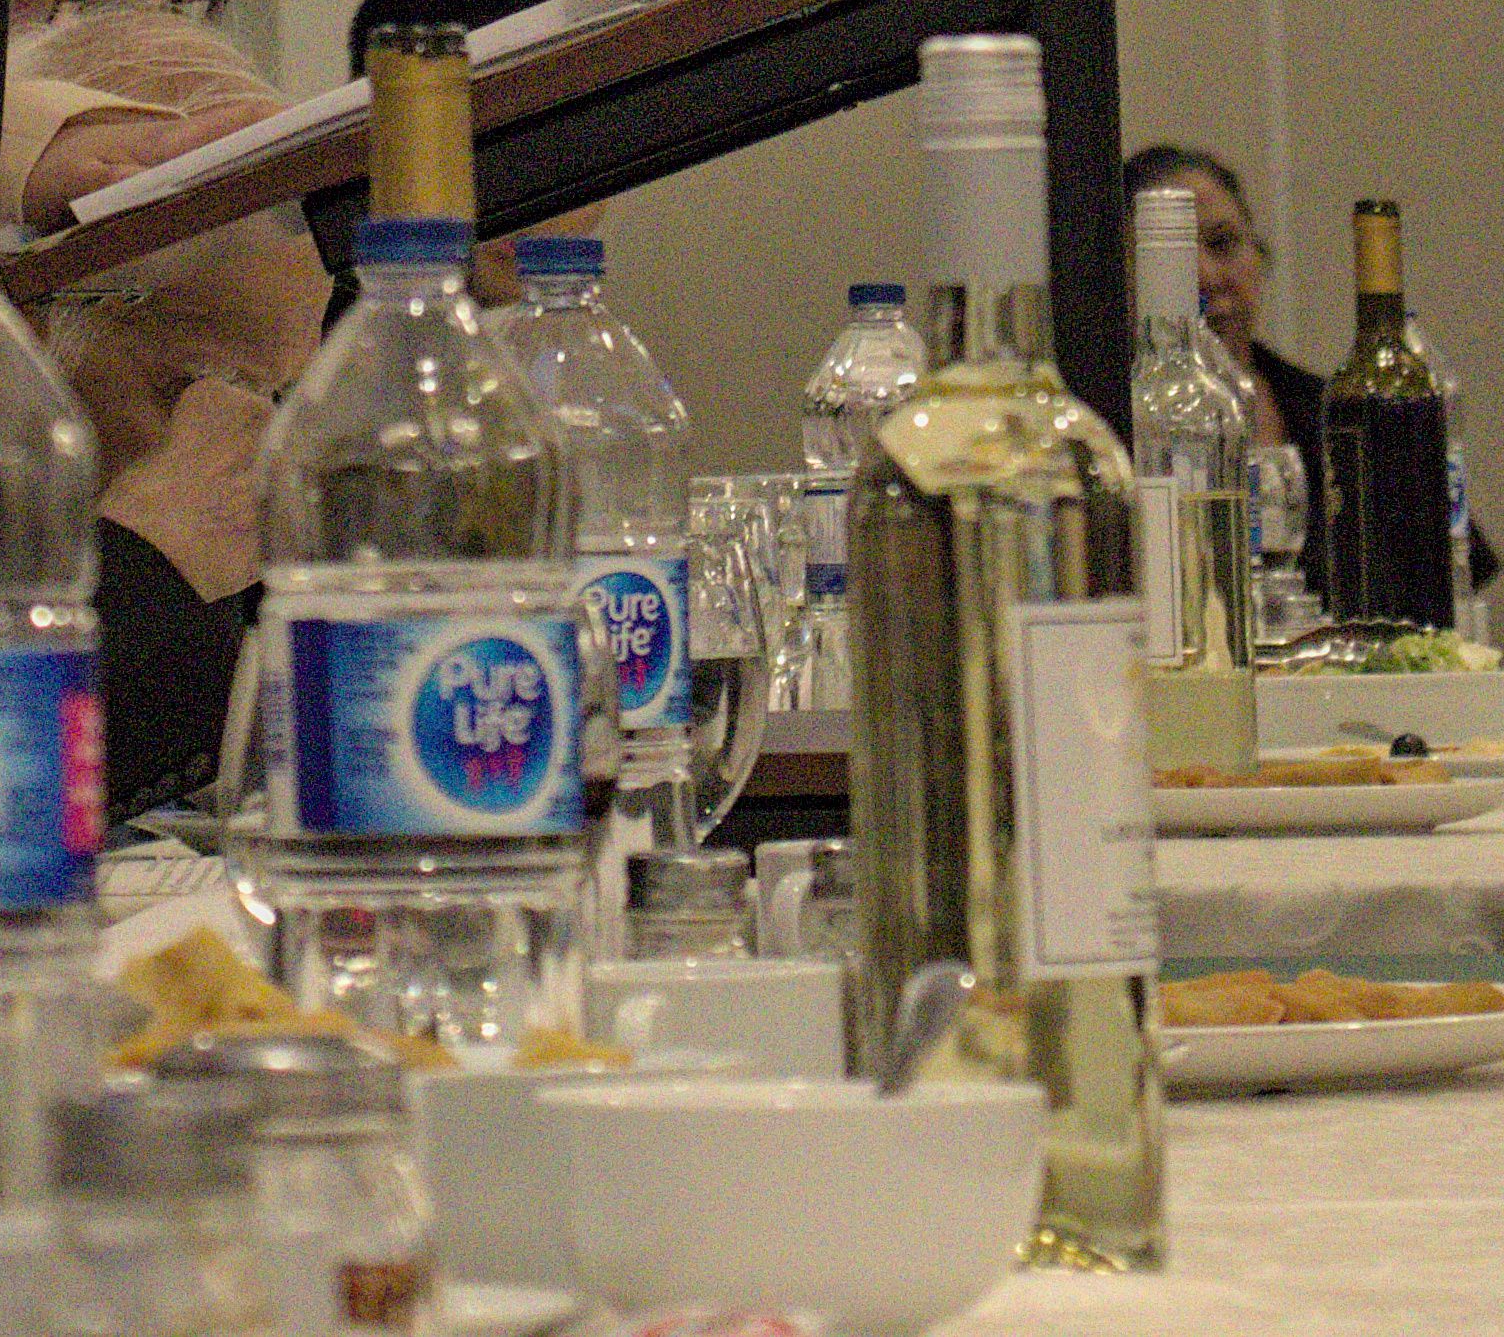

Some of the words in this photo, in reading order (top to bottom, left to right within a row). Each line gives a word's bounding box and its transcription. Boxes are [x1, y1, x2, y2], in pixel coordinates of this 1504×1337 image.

[581, 586, 662, 623] Pure
[609, 621, 653, 662] ife
[437, 655, 541, 701] Pure
[454, 701, 531, 753] Life
